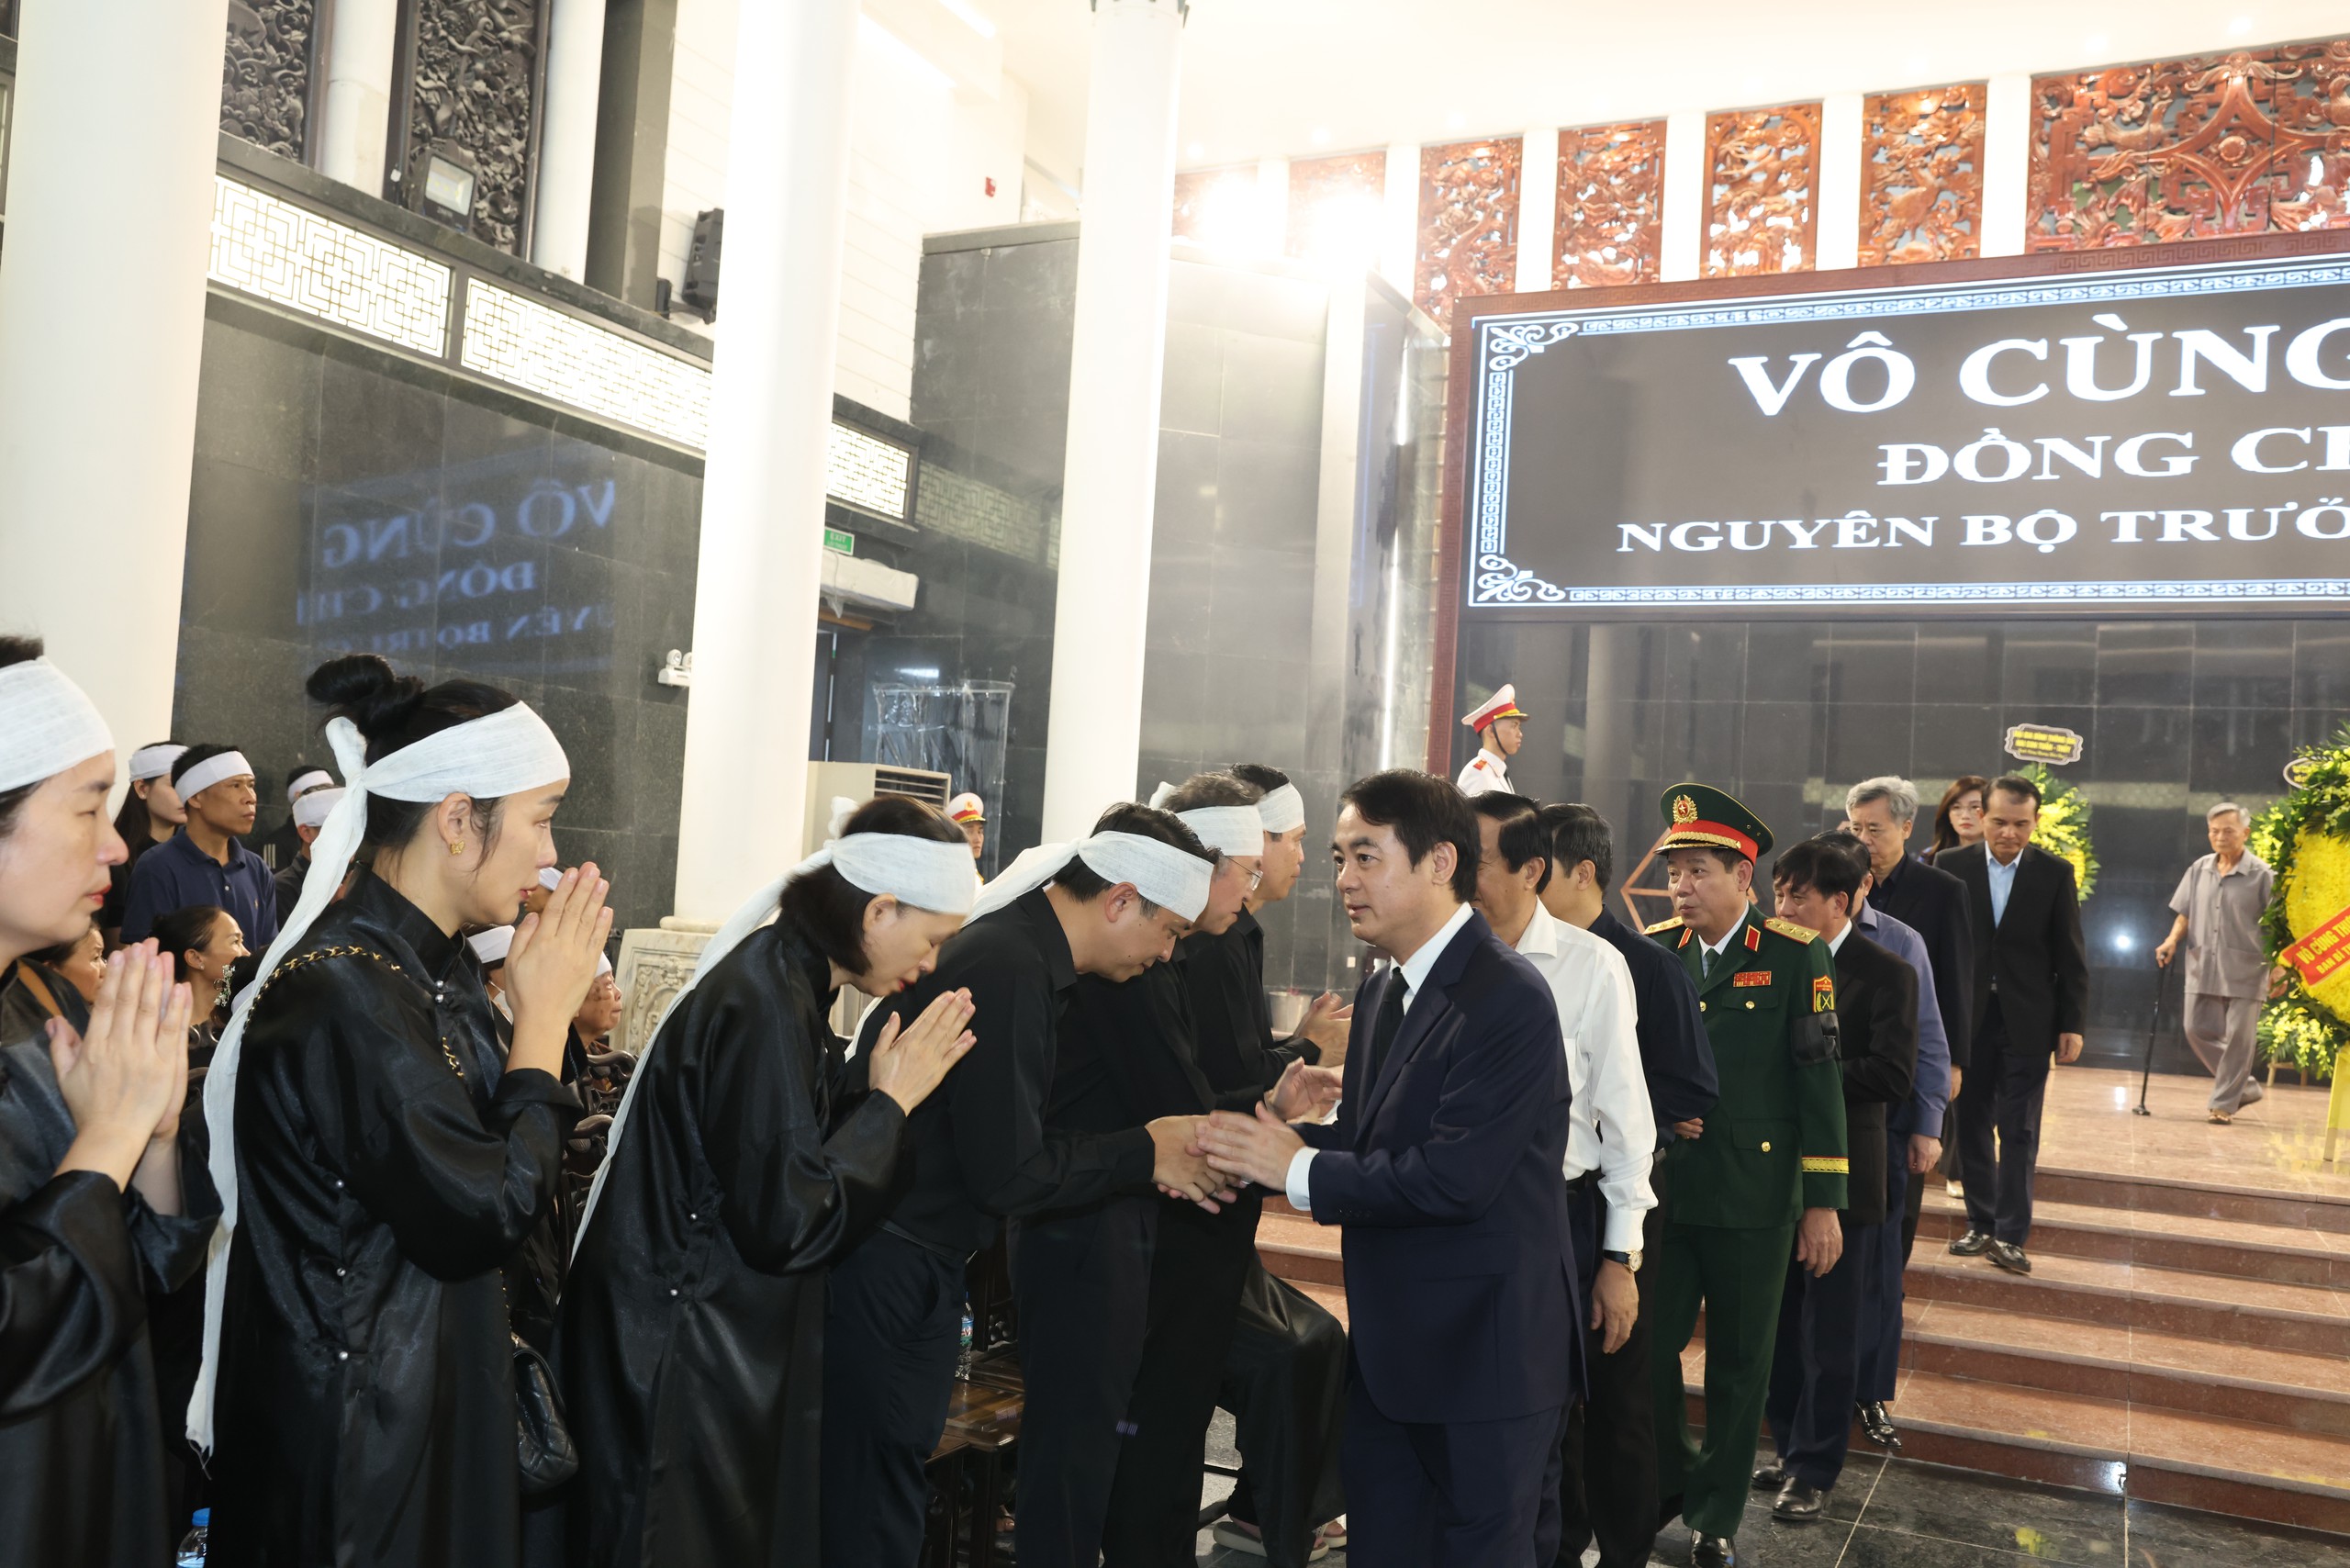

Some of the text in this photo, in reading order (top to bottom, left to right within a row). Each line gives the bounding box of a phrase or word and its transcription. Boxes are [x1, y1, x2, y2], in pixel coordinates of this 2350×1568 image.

[1728, 313, 2350, 416] VÔ CÙNG
[1876, 427, 2200, 485] ĐỒNG
[1616, 510, 1940, 552] NGUYÊN
[1959, 509, 2077, 553] BỘ
[2296, 946, 2315, 965] VÔ
